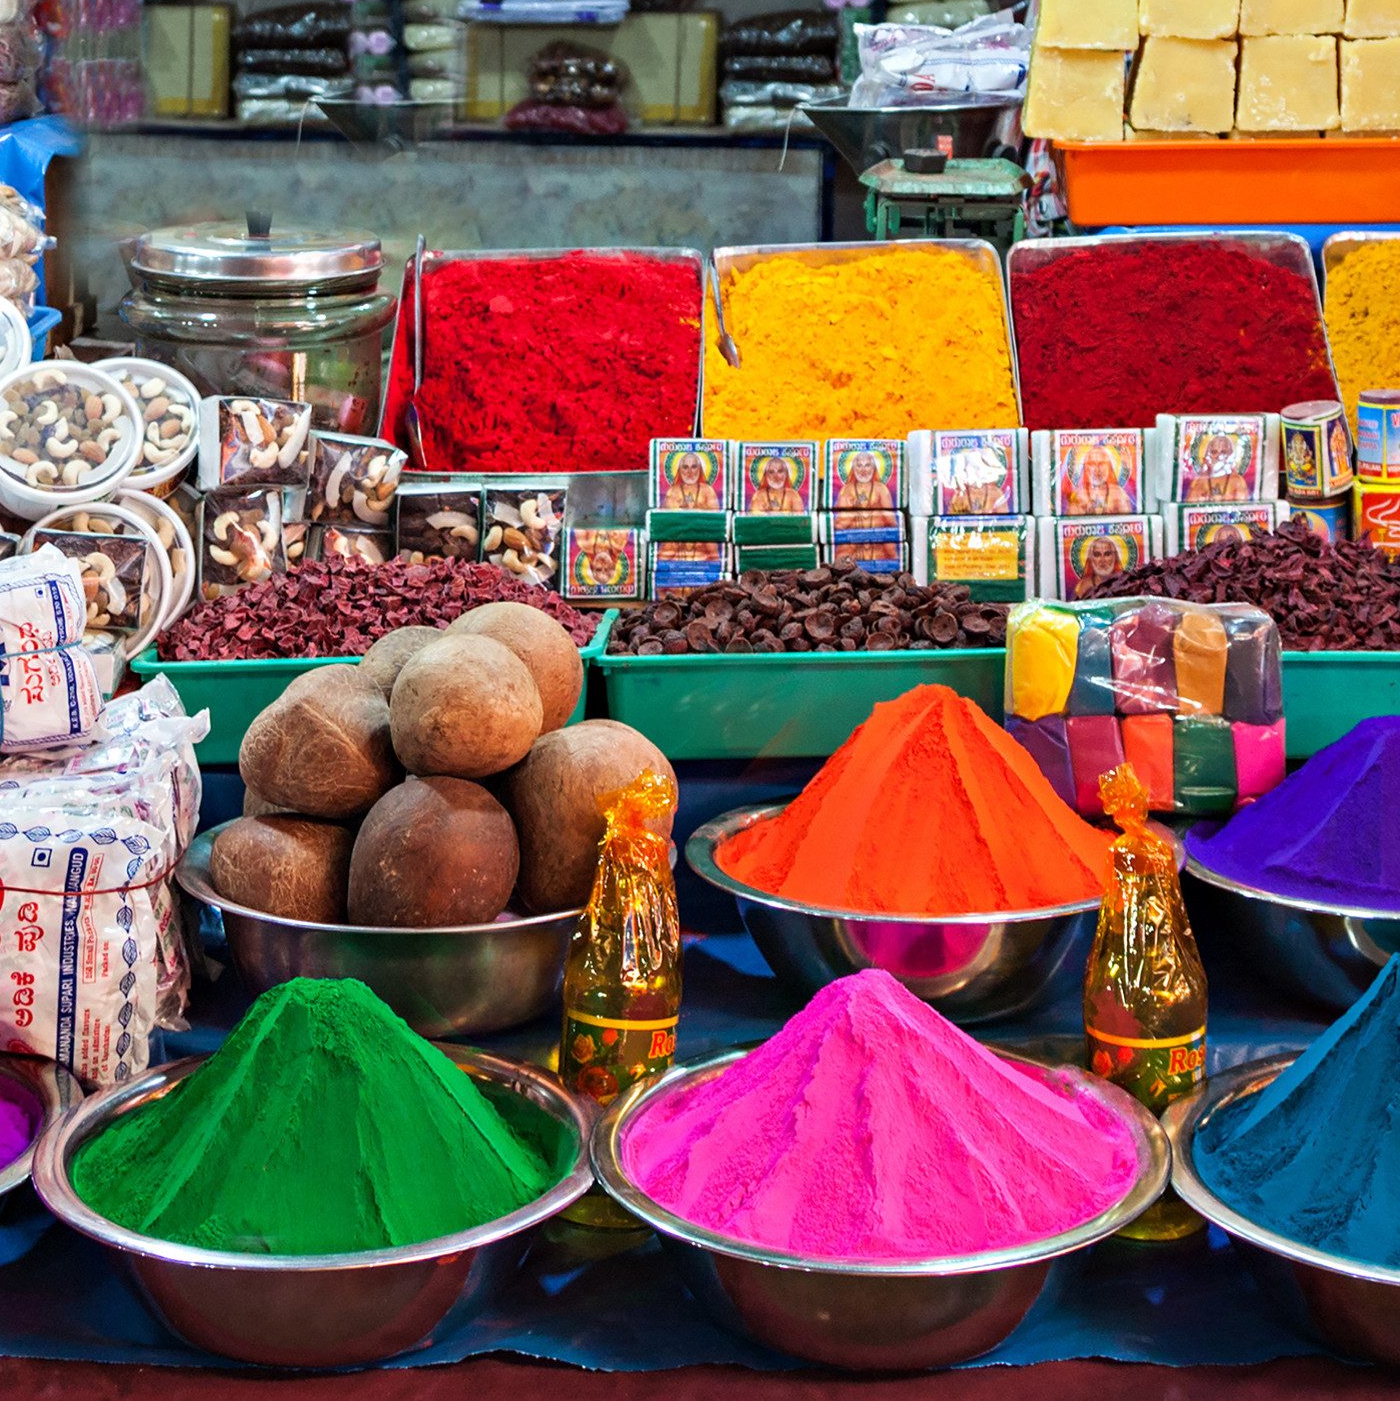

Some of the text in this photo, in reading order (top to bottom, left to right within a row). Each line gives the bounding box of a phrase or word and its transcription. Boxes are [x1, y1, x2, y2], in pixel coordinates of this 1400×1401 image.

[11, 902, 44, 1027] ಅಡಿಕೆ ಪುಡಿ
[61, 978, 76, 1013] SUPARI
[59, 1016, 74, 1063] MANANDA
[1168, 1045, 1205, 1076] Ros
